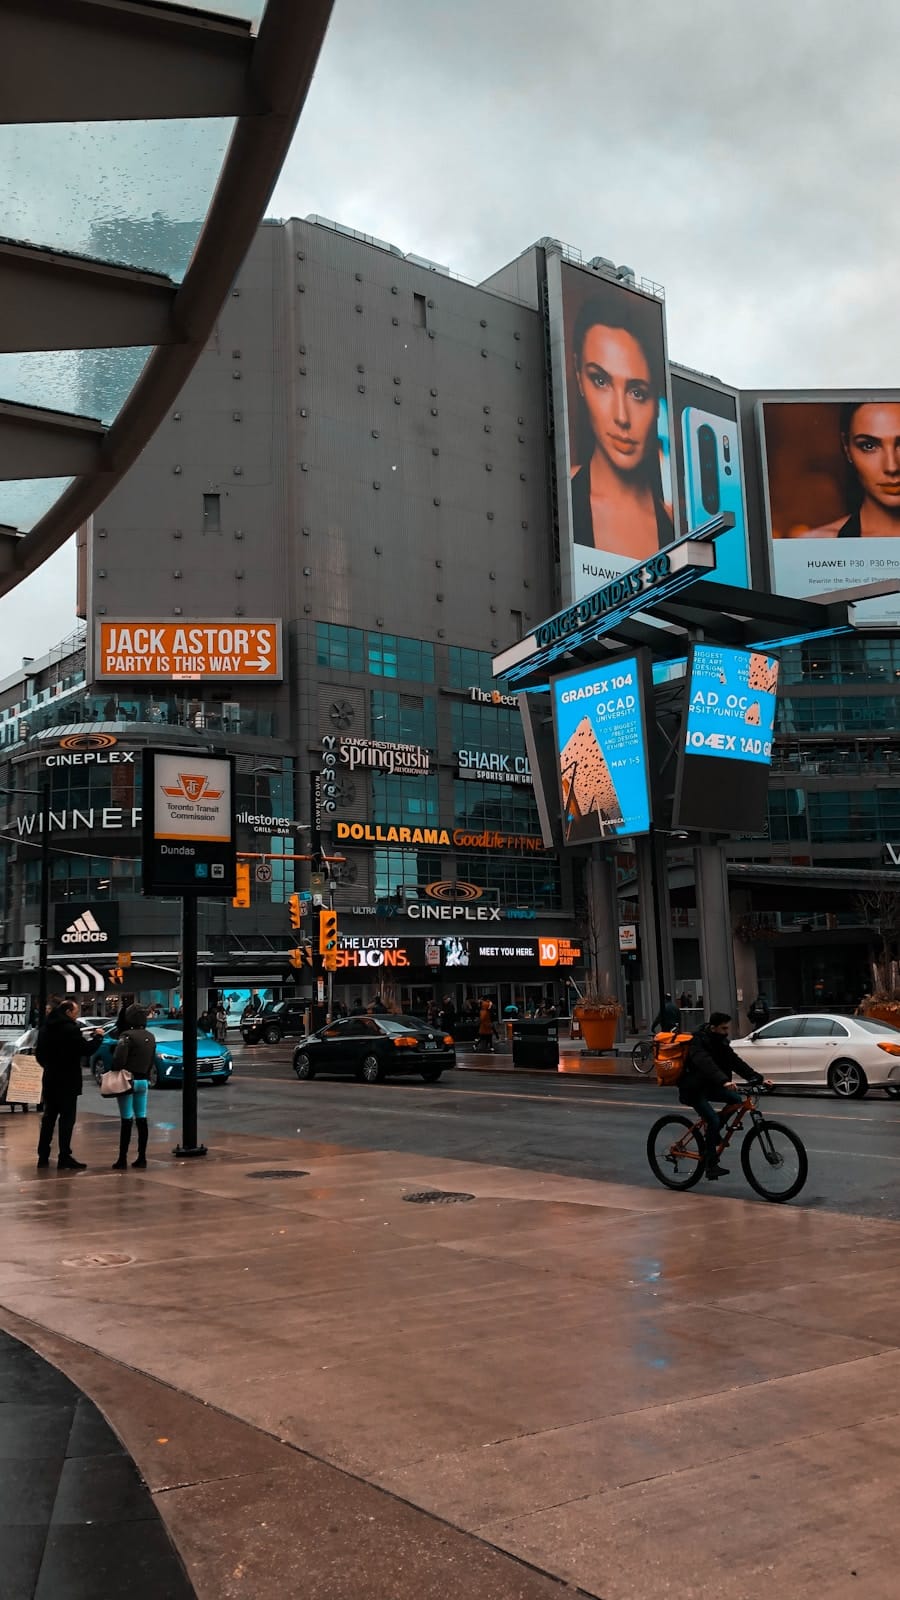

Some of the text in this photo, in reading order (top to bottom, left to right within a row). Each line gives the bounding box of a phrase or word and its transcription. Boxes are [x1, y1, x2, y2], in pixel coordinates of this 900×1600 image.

[807, 560, 846, 568] HUAWEI
[849, 560, 864, 568] P30
[886, 559, 899, 567] Pro
[534, 552, 671, 648] YONGE-DUNDAS SQ
[106, 628, 271, 655] JACK ASTOR'S
[106, 656, 241, 672] PARTY IS THIS WAY
[561, 673, 632, 704] GRADEX 104
[596, 695, 635, 715] OCAD
[692, 691, 719, 705] AD
[596, 708, 635, 723] UNIVERSITY
[340, 736, 416, 752] LOUNGE RESTAURANT
[46, 752, 135, 766] CINEPLEX
[458, 749, 510, 772] SHARK
[611, 759, 627, 768] MAY
[476, 771, 503, 780] SPORTS
[506, 772, 519, 782] BAR
[167, 802, 219, 813] Toronto Transit
[170, 812, 216, 822] Commission
[337, 822, 450, 845] DOLLARAMA
[453, 829, 545, 851] GoodLife FITNE
[160, 845, 195, 856] Dundas
[352, 906, 376, 915] ULTRA
[407, 904, 501, 920] CINEPLEX
[61, 929, 108, 943] adidas
[340, 937, 399, 949] THE LATEST
[479, 947, 535, 956] MEET YOU HERE.
[541, 943, 557, 960] 10
